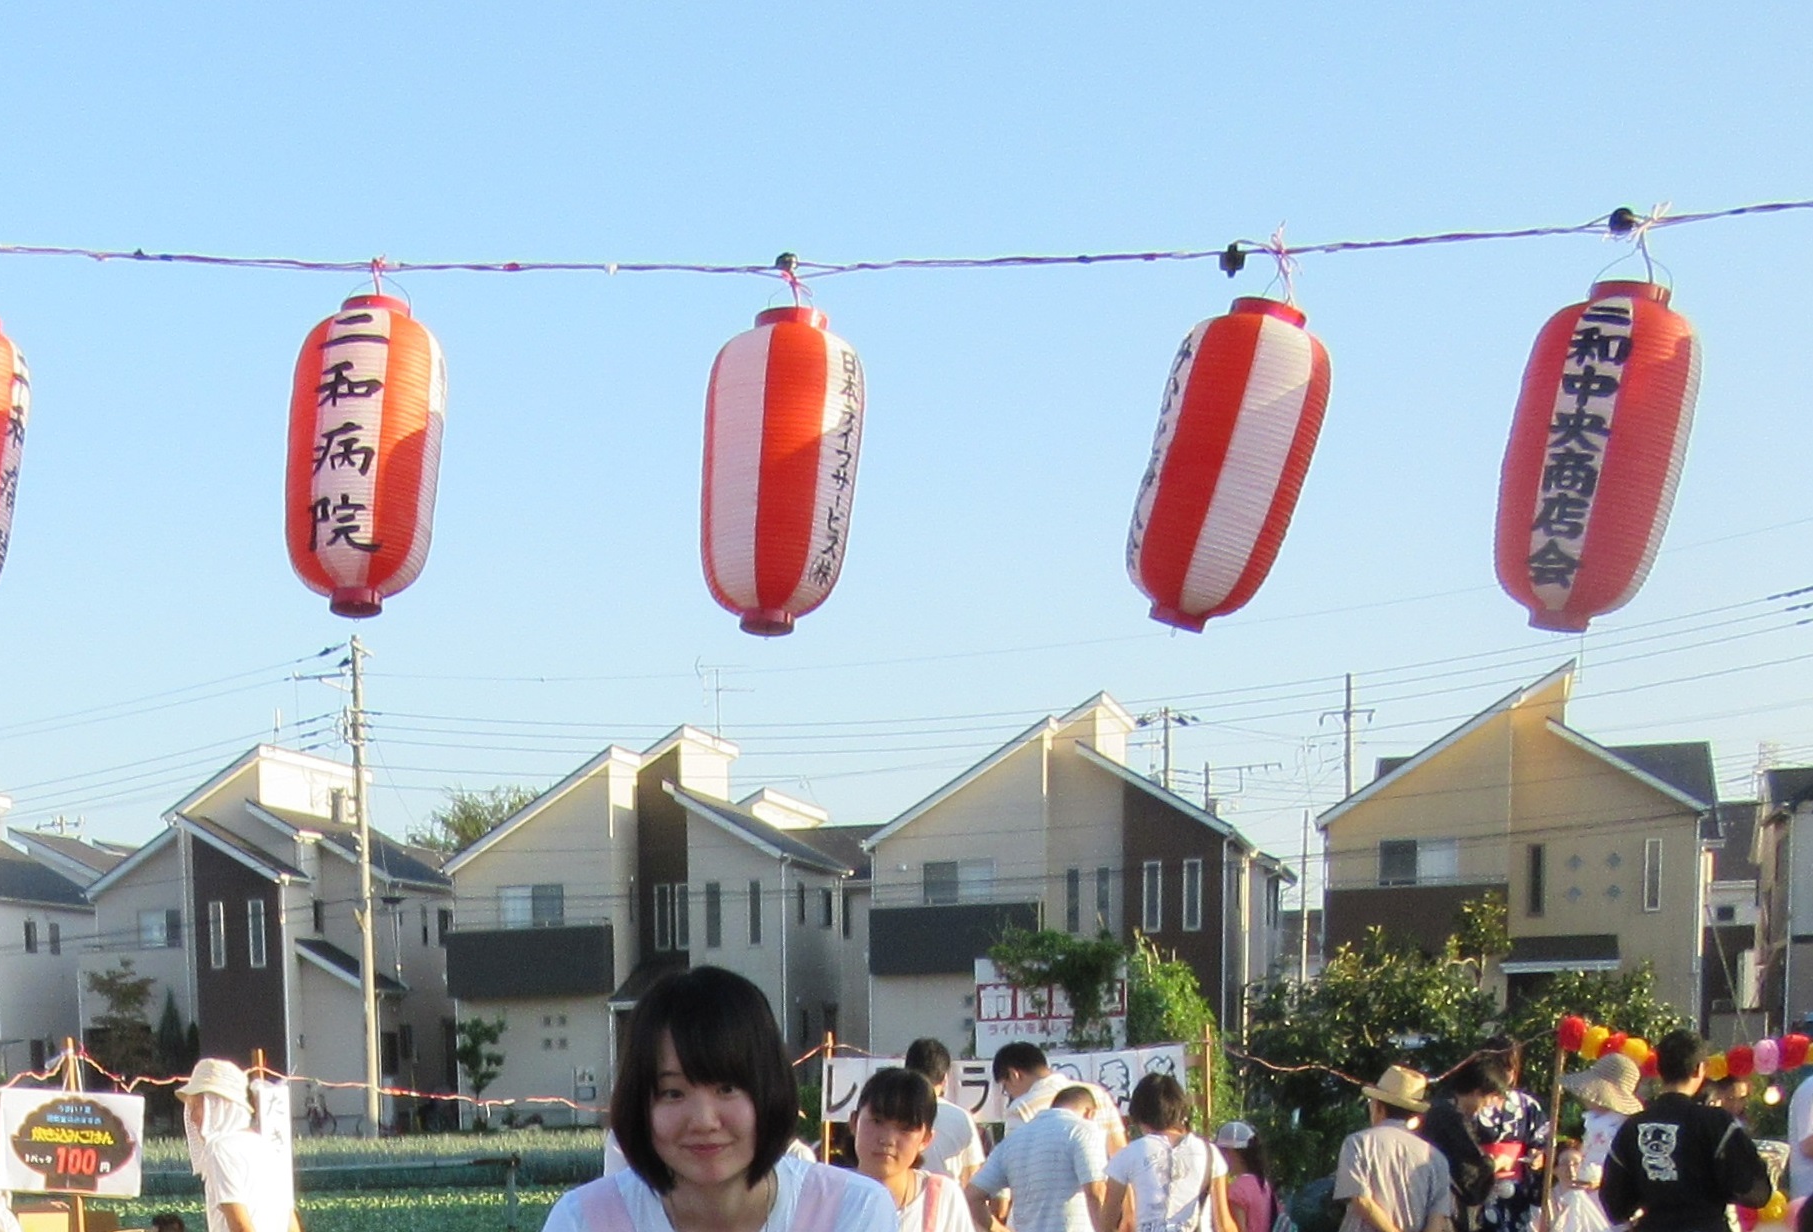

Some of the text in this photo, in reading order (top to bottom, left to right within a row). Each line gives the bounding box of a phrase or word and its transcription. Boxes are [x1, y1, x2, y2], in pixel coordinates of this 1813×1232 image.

[307, 312, 391, 552] 二和病院
[56, 1146, 97, 1175] 100
